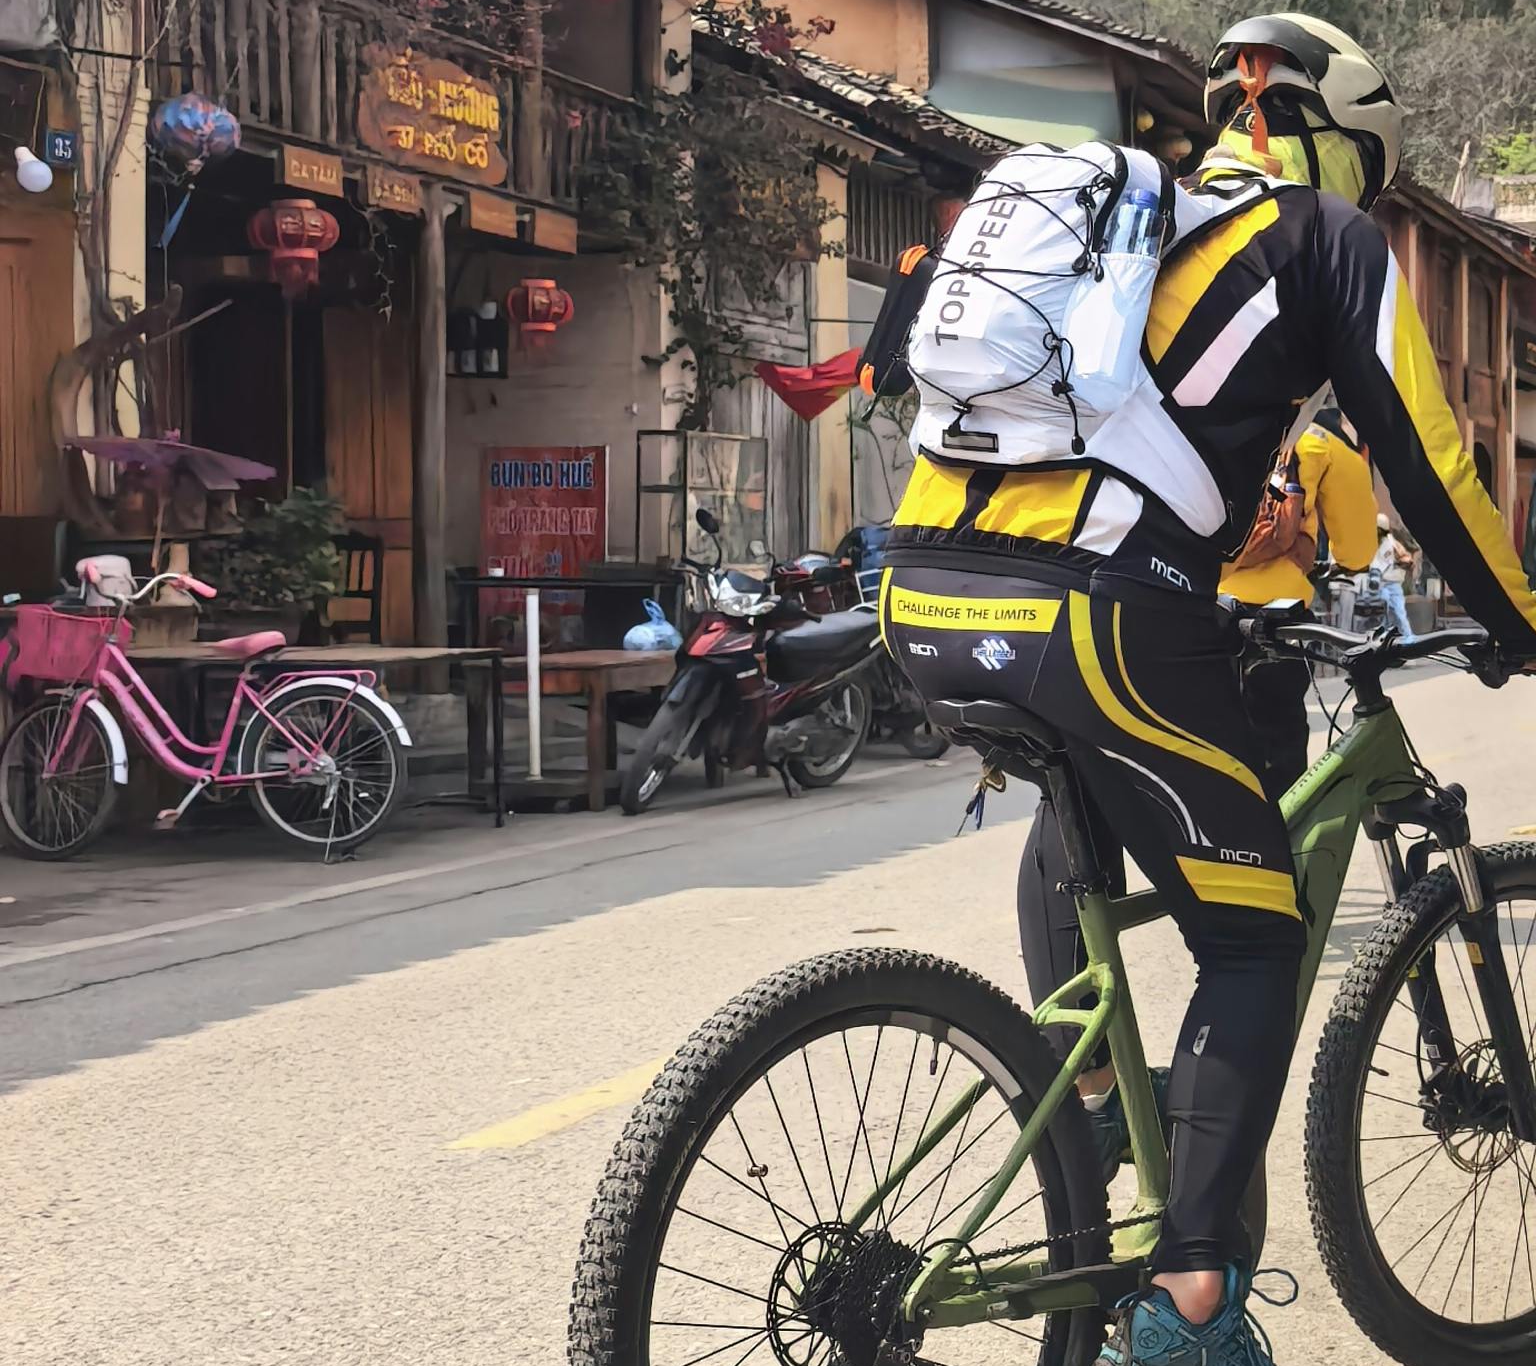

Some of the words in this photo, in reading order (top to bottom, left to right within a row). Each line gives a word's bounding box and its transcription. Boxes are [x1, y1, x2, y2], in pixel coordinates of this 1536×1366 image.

[898, 600, 961, 620] CHALLENGE
[966, 607, 989, 620] THE
[995, 609, 1037, 621] LIMITS
